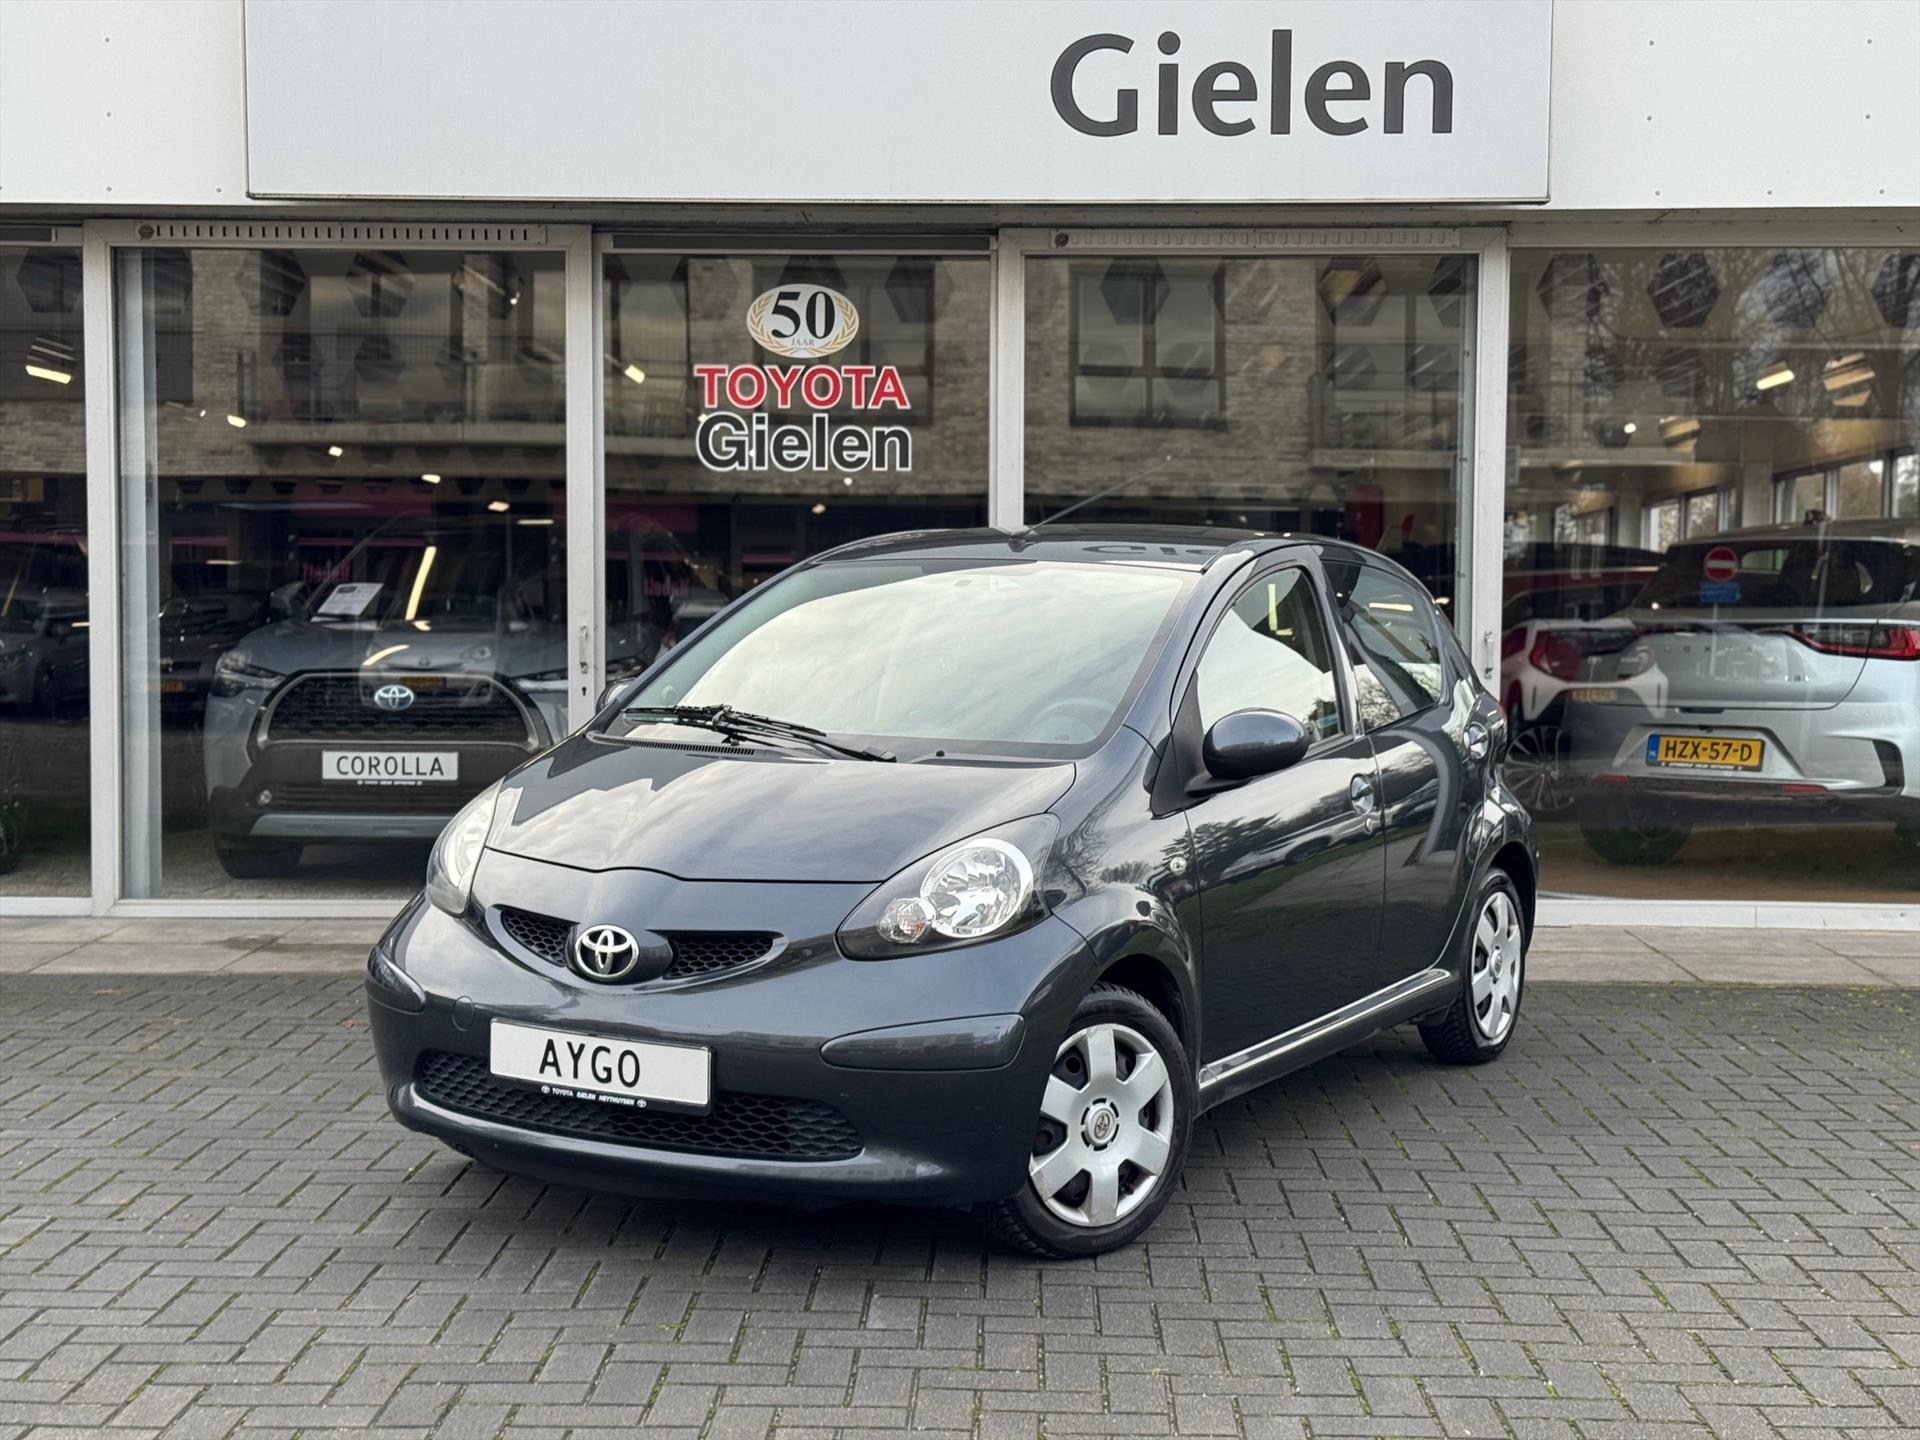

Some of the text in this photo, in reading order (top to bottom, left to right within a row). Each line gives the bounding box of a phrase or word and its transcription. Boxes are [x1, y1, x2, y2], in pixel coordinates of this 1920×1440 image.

[1050, 29, 1453, 137] Gielen
[771, 290, 836, 340] 50
[790, 338, 815, 347] JAAR
[693, 364, 911, 410] TOYOTA
[696, 411, 912, 472] Gielen
[336, 755, 444, 776] COROLLA
[1664, 739, 1753, 762] HZX-57-D
[538, 1038, 641, 1088] AYGO
[552, 1087, 574, 1097] TOYOTA
